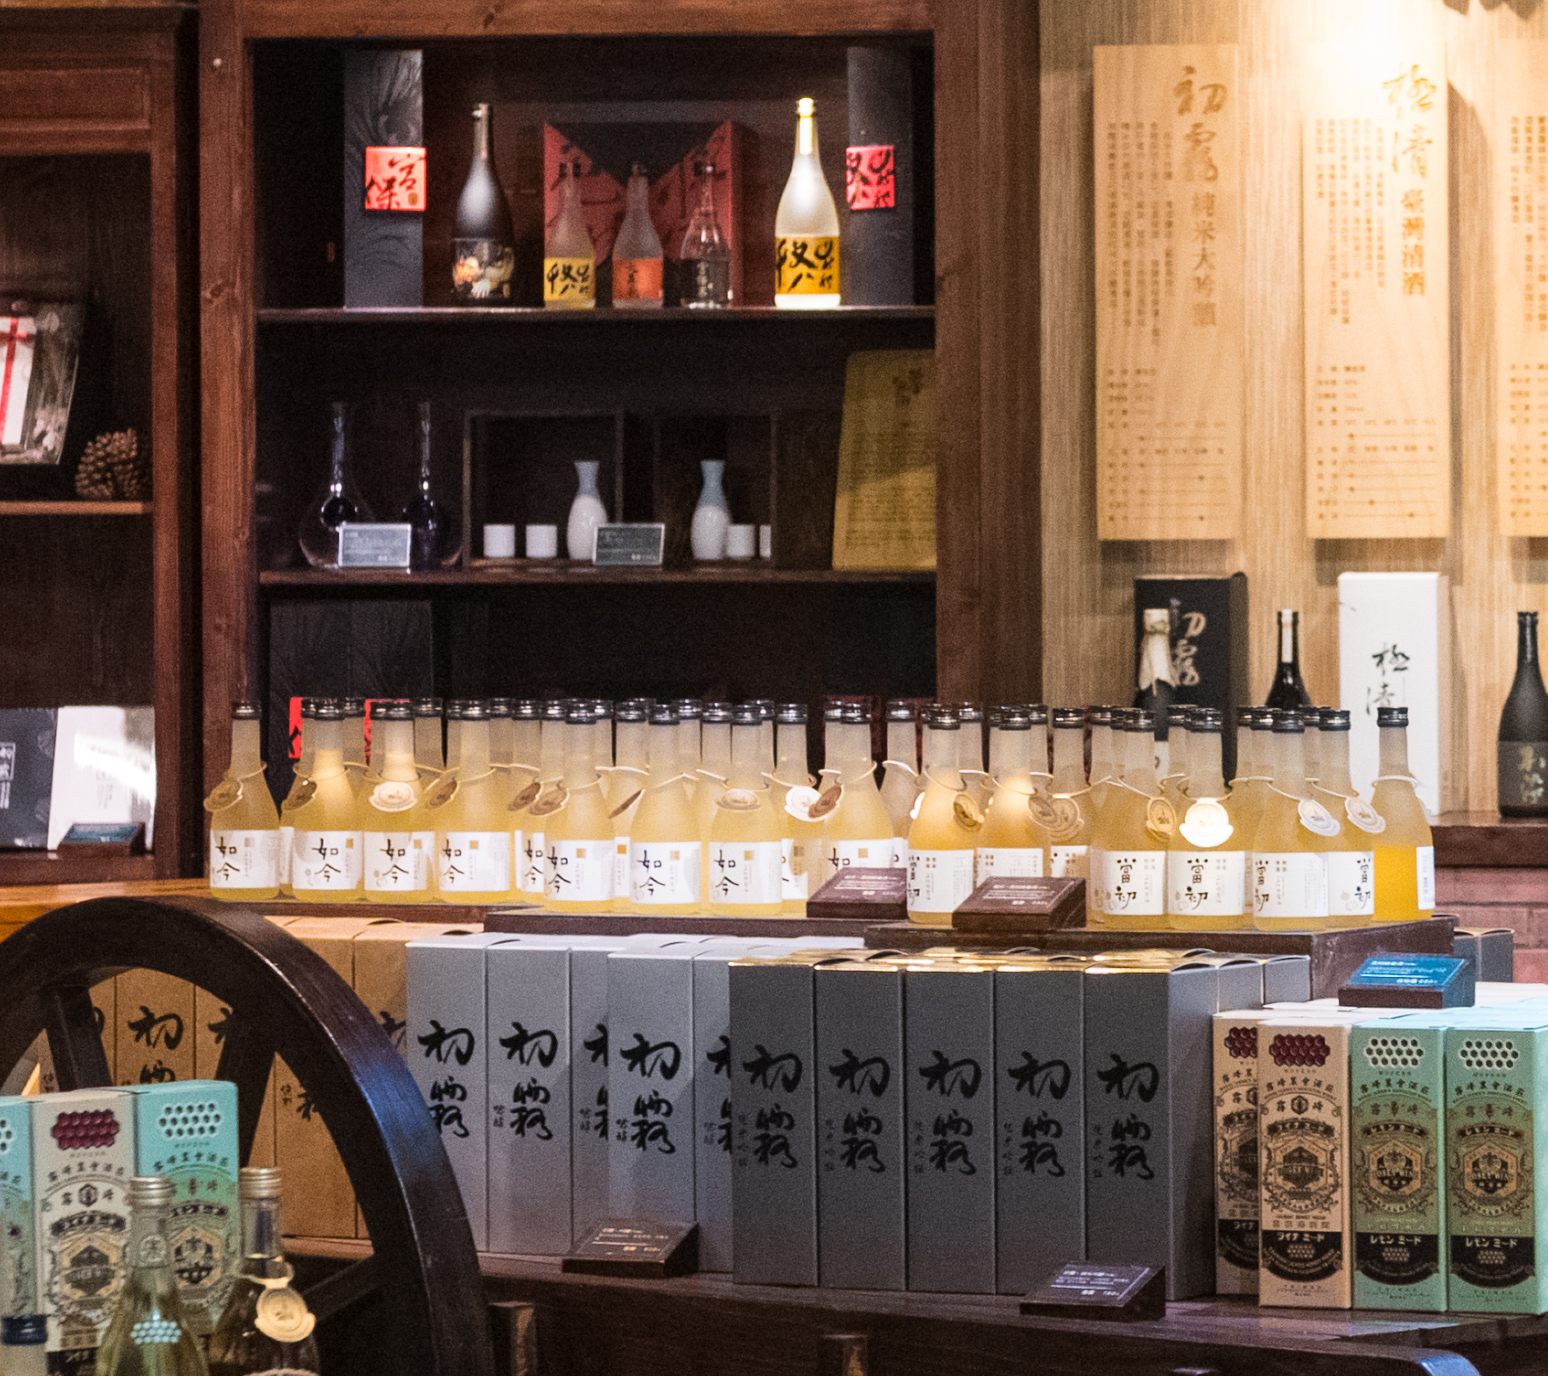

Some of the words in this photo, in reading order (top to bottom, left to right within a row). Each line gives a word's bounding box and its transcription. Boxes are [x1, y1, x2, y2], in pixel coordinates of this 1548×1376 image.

[214, 835, 240, 884] 如今
[312, 837, 341, 883] 如今
[379, 837, 409, 880] 如今
[441, 839, 467, 883] 如今
[546, 845, 574, 896] 如今
[636, 849, 666, 896] 如今
[714, 848, 741, 896] 如今
[128, 1006, 184, 1084] 初
[417, 1018, 476, 1141] 初霧
[498, 1020, 559, 1141] 初霧
[620, 1031, 682, 1157] 初霧
[740, 1043, 803, 1171] 初霧
[828, 1048, 891, 1175] 初霧
[918, 1048, 982, 1176] 初霧
[1007, 1050, 1072, 1180] 初霧
[1096, 1052, 1160, 1182] 初霧
[1369, 1235, 1395, 1244] レモン
[1464, 1238, 1490, 1248] レモン
